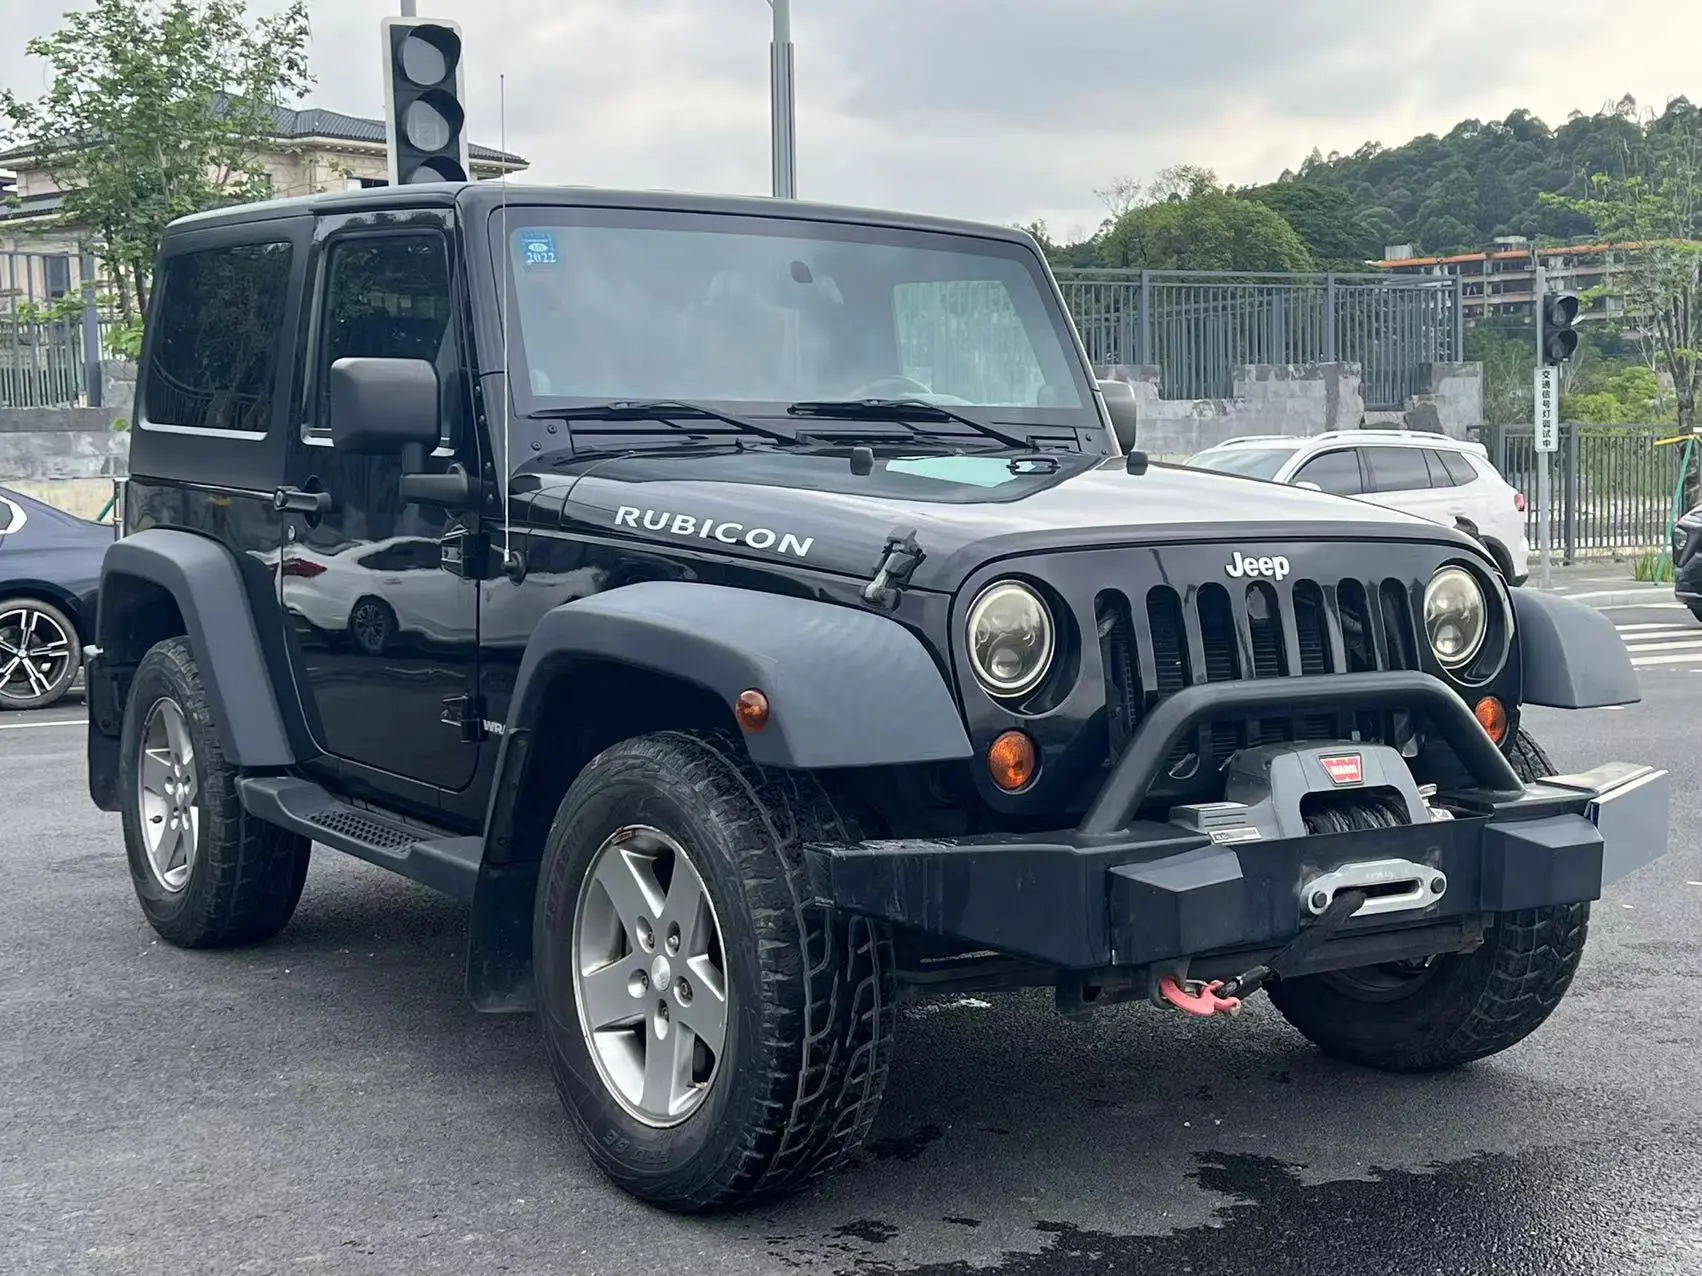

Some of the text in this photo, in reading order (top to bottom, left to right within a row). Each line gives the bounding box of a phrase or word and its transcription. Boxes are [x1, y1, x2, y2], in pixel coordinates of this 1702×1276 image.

[526, 252, 557, 264] 2022
[614, 505, 815, 557] RUBICON
[1225, 551, 1290, 581] Jeep
